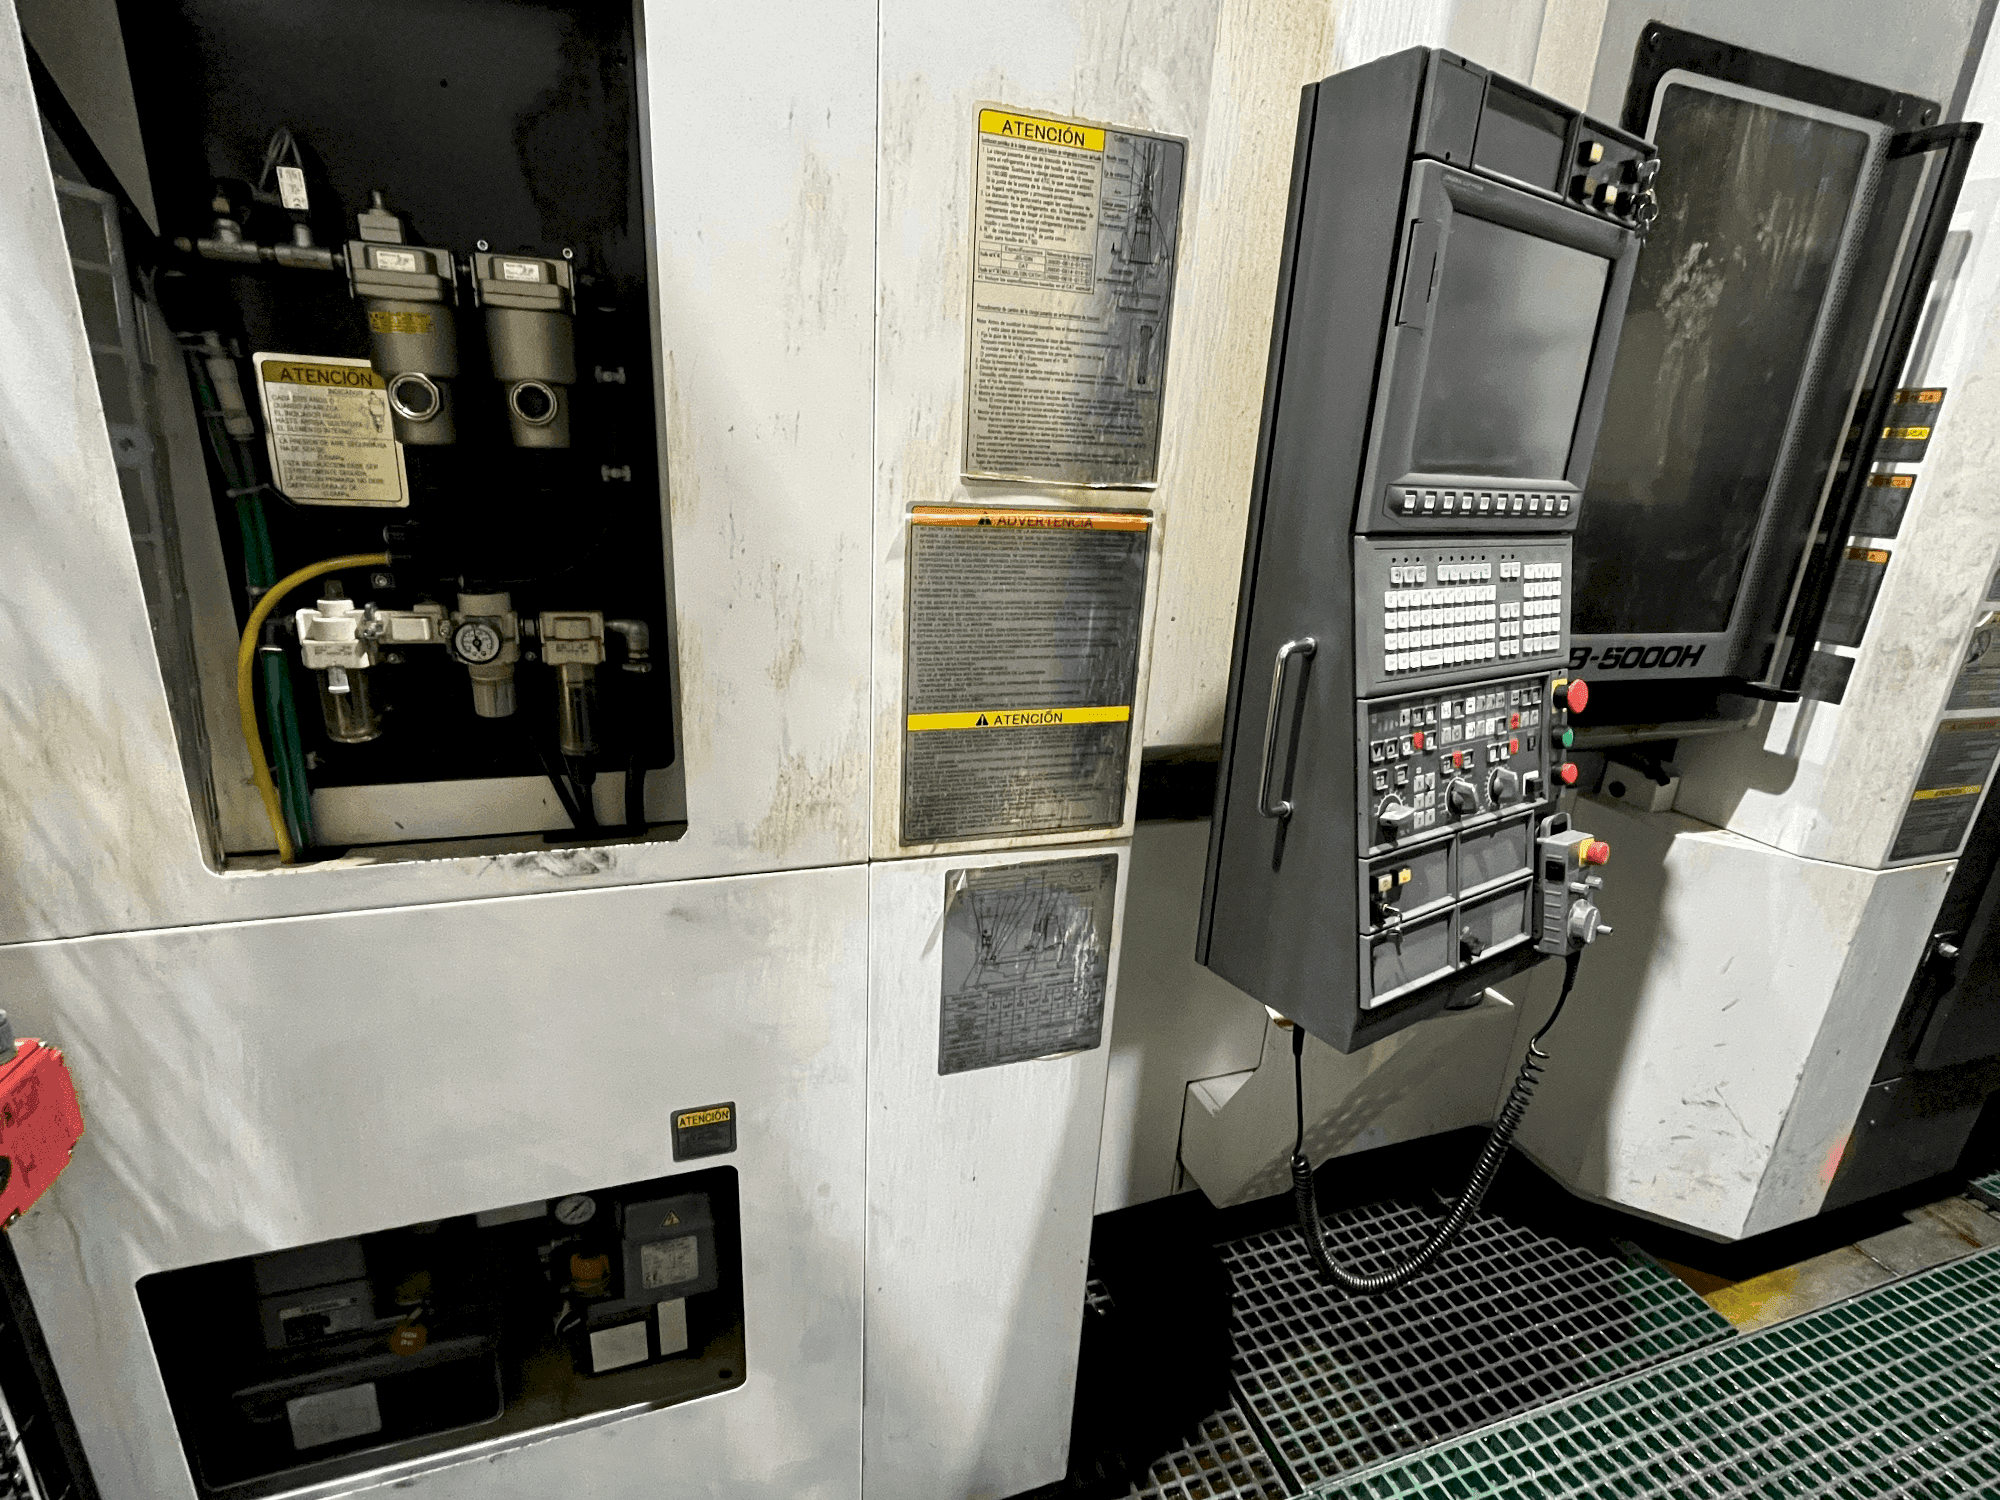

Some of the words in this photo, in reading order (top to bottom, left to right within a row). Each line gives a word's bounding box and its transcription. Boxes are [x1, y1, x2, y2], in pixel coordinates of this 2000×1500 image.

[1002, 119, 1085, 146] ATENCIÓN
[281, 367, 372, 387] ATENCIÓN
[997, 516, 1093, 528] ADVERTENCIA
[1569, 645, 1706, 669] B-5000H
[994, 710, 1063, 725] ATENCIÓN
[680, 1109, 729, 1126] ATENCIÓN
